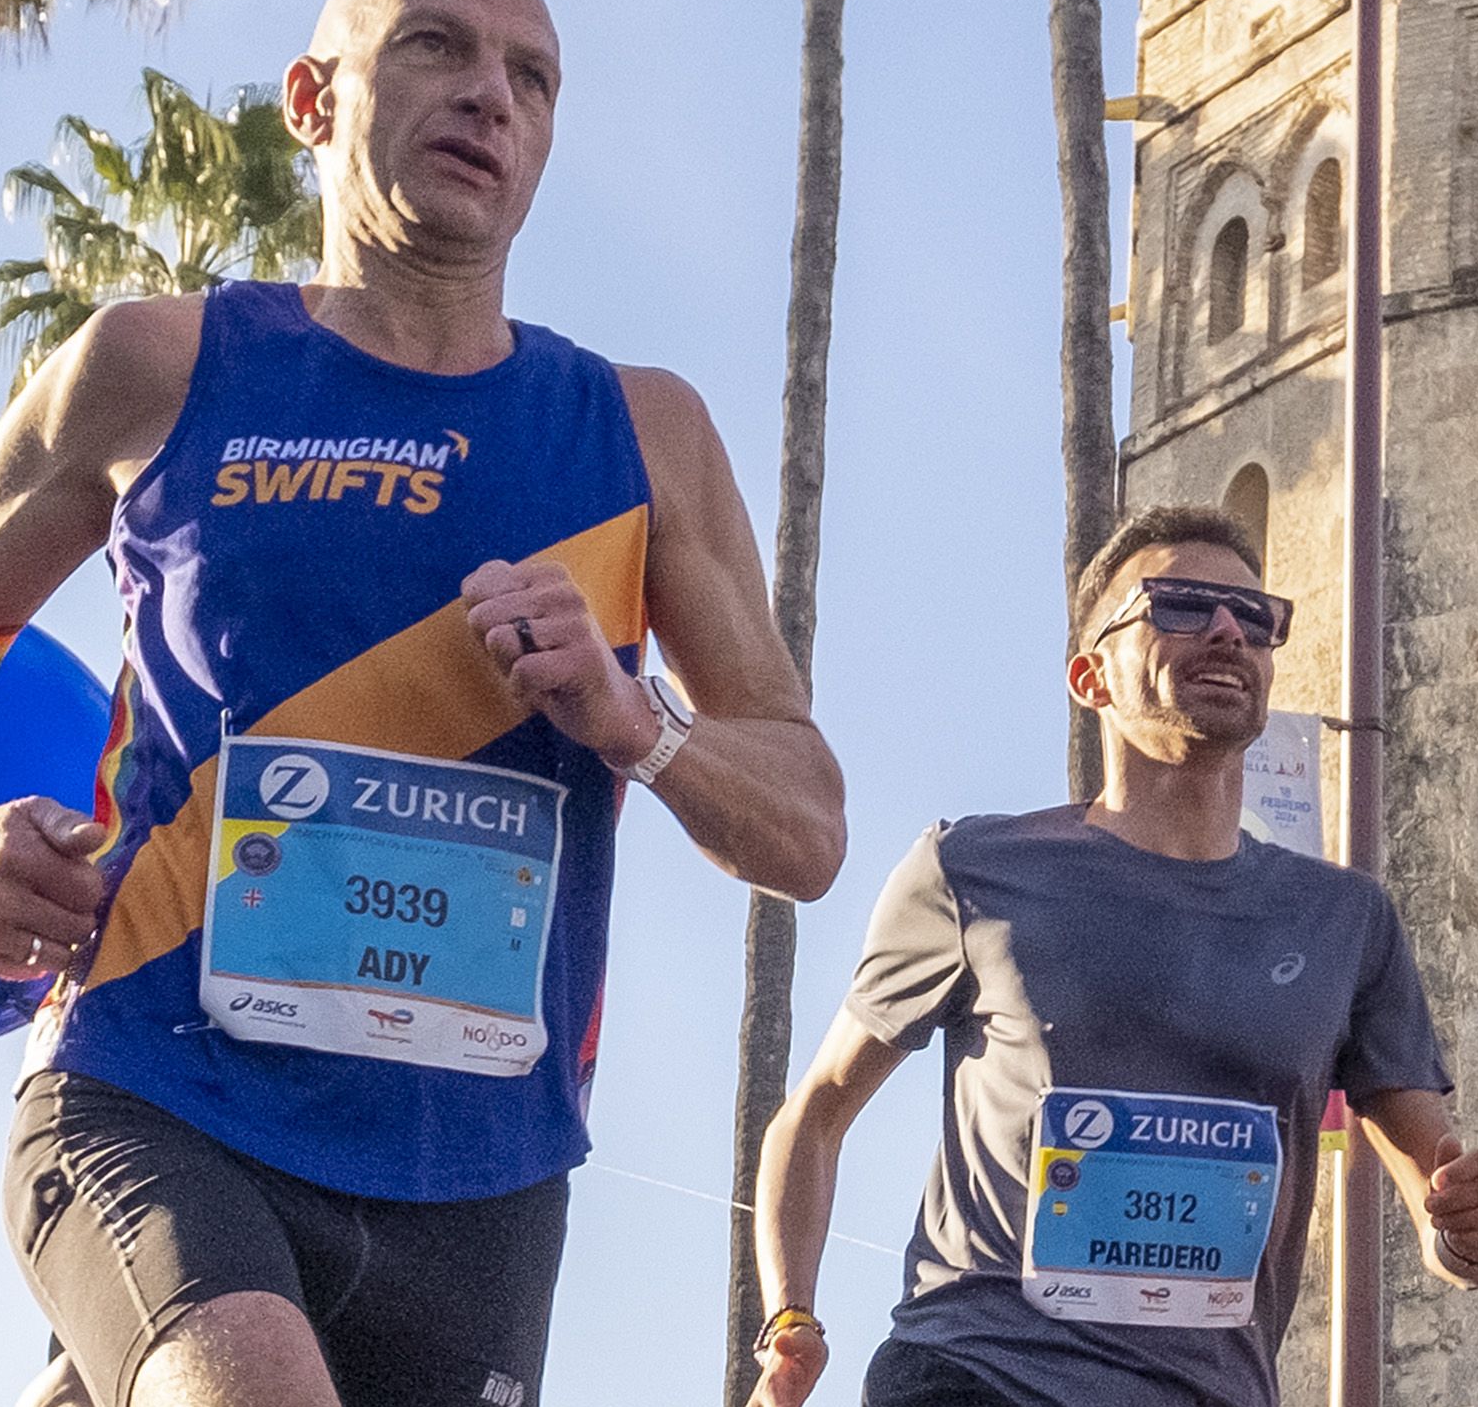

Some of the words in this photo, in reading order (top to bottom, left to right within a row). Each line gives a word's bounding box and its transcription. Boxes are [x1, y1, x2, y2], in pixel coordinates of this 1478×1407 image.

[220, 436, 451, 471] BIRMINGHAM
[210, 460, 445, 515] SWIFTS
[351, 777, 528, 837] ZURICH
[344, 873, 449, 929] 3939
[356, 945, 431, 986] ADY
[1128, 1113, 1254, 1150] ZURICH
[1123, 1189, 1199, 1224] 3812
[1088, 1239, 1222, 1272] PAREDERO
